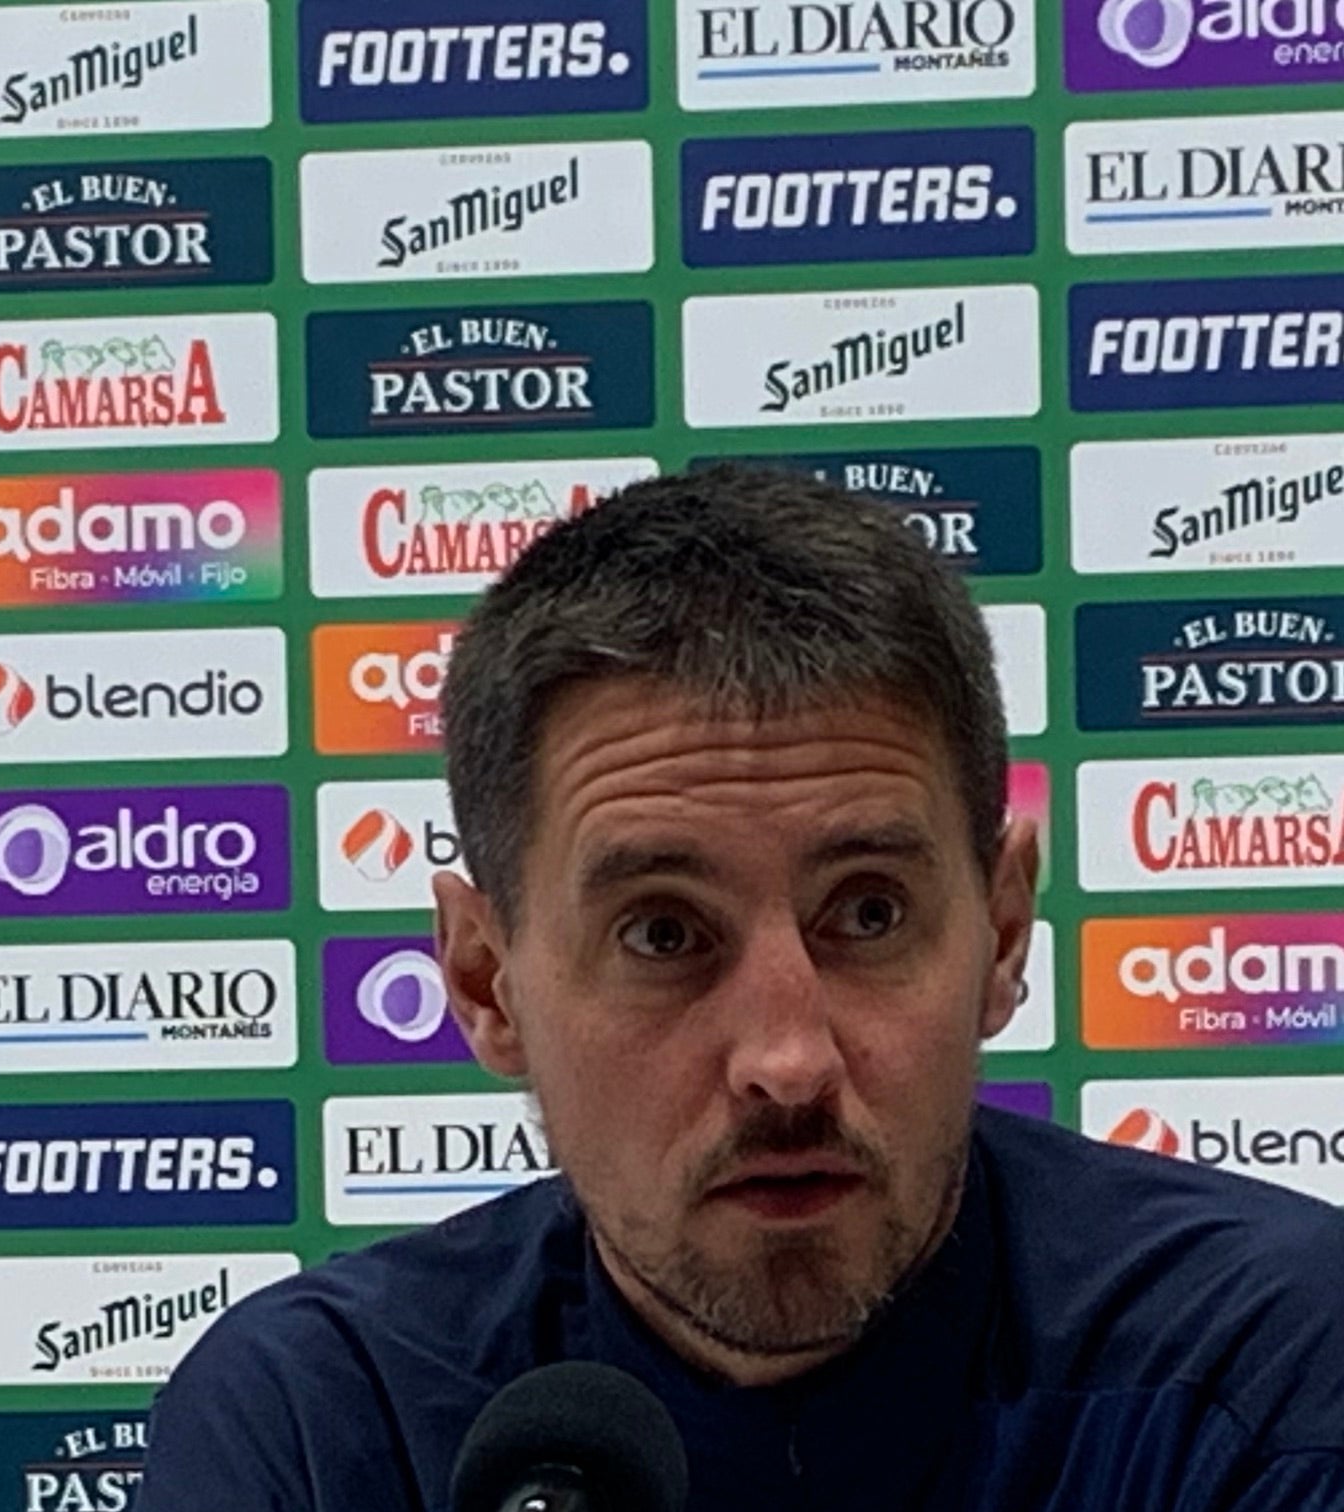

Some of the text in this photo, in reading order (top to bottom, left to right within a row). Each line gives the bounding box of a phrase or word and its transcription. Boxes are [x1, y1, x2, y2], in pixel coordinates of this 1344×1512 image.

[1087, 150, 1168, 203] EL
[410, 318, 549, 356] EL BUEN
[370, 366, 592, 415] PASTOR
[30, 562, 247, 591] Fibra Móvil Fijo
[1182, 610, 1324, 649] EL BUEN
[45, 669, 263, 721] blendio
[74, 805, 256, 871] aldro
[57, 968, 277, 1023] DIARIO
[1179, 1006, 1247, 1031] Fibra
[1264, 1003, 1337, 1030] Móvil
